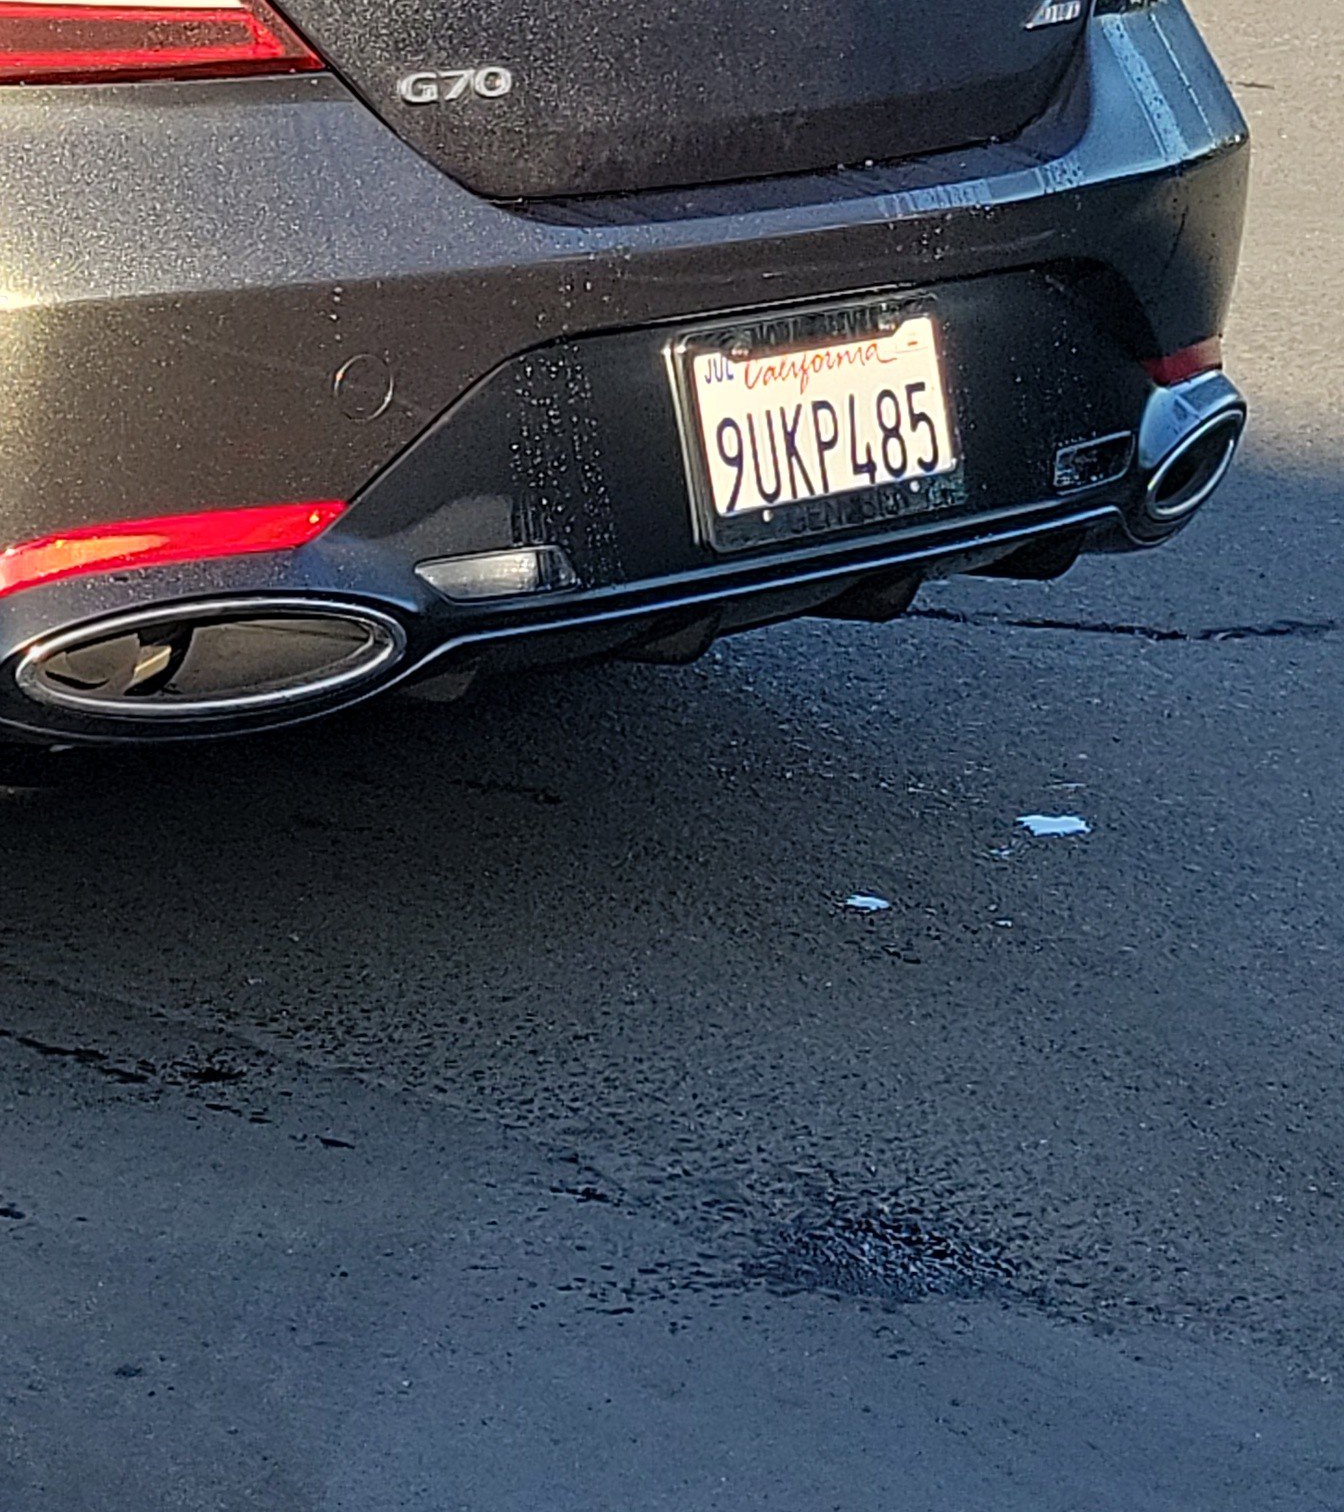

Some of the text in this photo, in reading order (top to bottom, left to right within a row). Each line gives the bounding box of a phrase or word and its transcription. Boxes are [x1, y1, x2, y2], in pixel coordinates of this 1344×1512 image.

[396, 65, 513, 105] G70
[744, 342, 896, 395] California
[715, 382, 940, 513] 9UKP485
